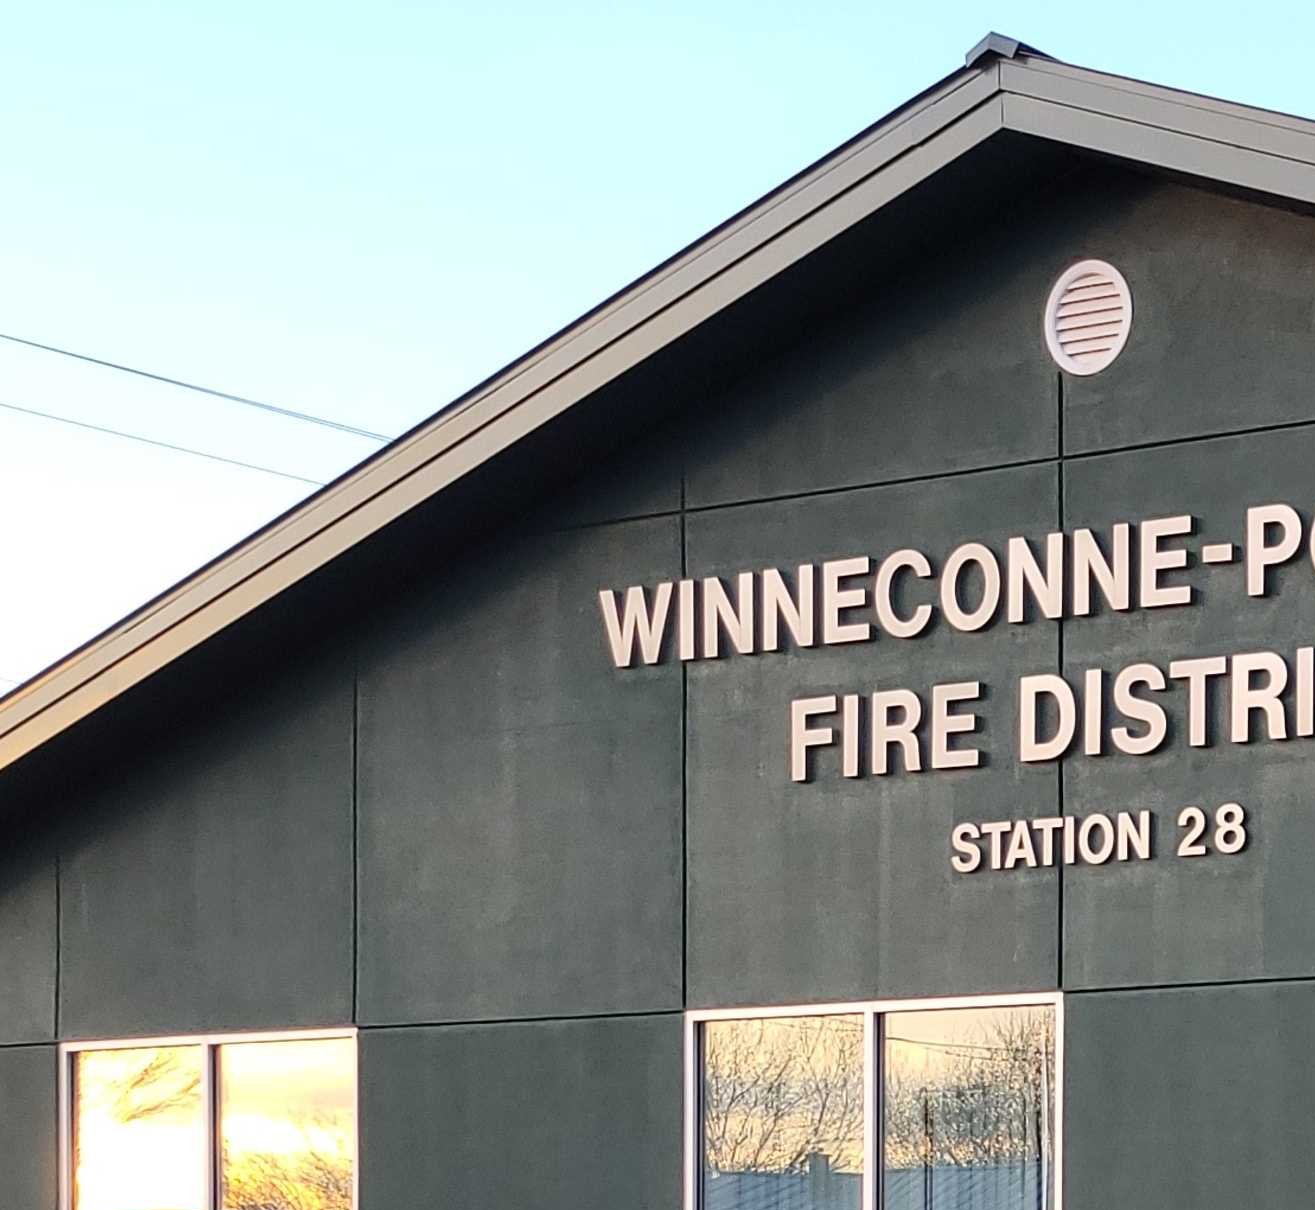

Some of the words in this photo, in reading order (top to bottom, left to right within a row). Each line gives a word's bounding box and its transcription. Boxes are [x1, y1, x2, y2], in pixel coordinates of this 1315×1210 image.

[790, 681, 980, 783] FIRE
[951, 810, 1150, 873] STATION
[1176, 803, 1246, 857] 28
